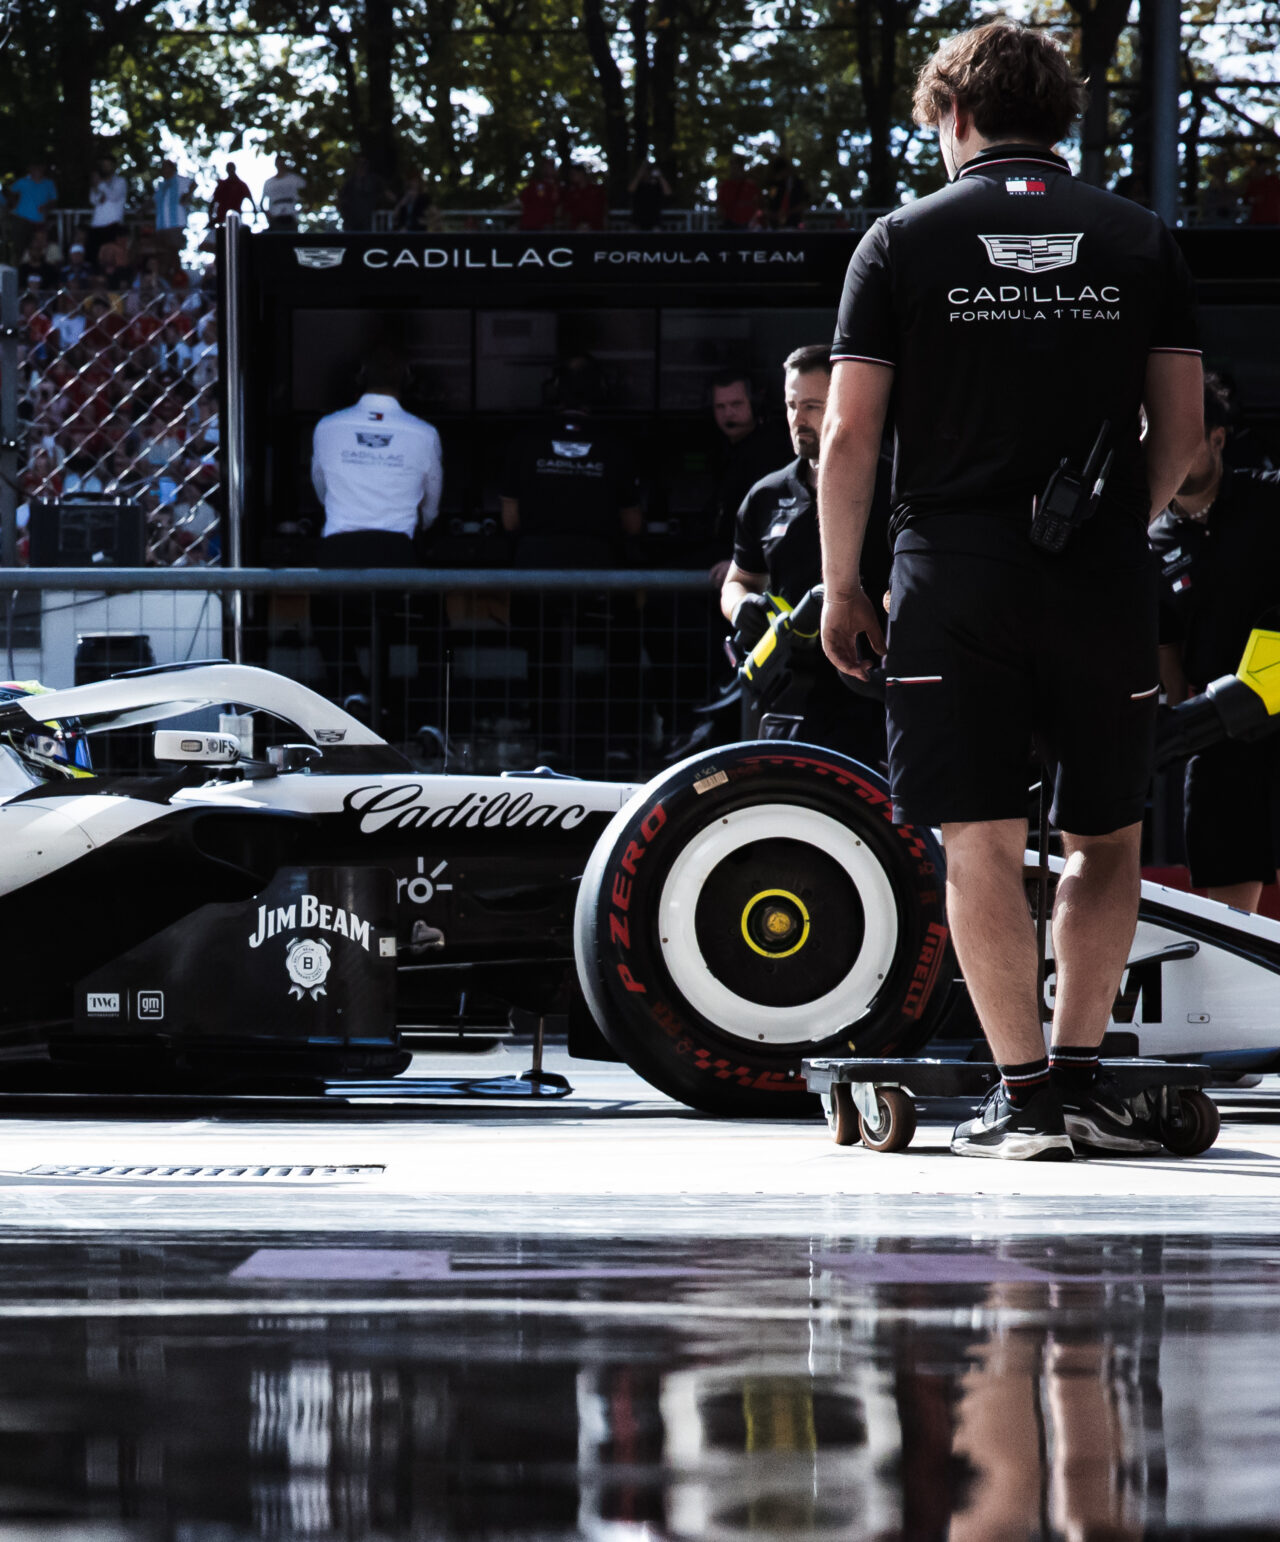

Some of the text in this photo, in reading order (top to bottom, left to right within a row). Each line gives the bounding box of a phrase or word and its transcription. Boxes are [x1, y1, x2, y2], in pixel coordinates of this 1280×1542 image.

[363, 248, 573, 268] CADILLAC
[593, 251, 710, 263] FORMULA
[738, 251, 805, 263] TEAM
[948, 285, 1120, 304] CADILLAC
[950, 309, 1046, 322] FORMULA
[1070, 309, 1120, 320] TEAM
[343, 784, 585, 834] Cadillac
[609, 803, 668, 950] ZERO
[248, 894, 370, 952] JIM BEAM
[303, 957, 313, 969] B
[901, 921, 949, 1020] PIRELLI
[617, 963, 647, 993] P
[90, 997, 160, 1013] TWG gm
